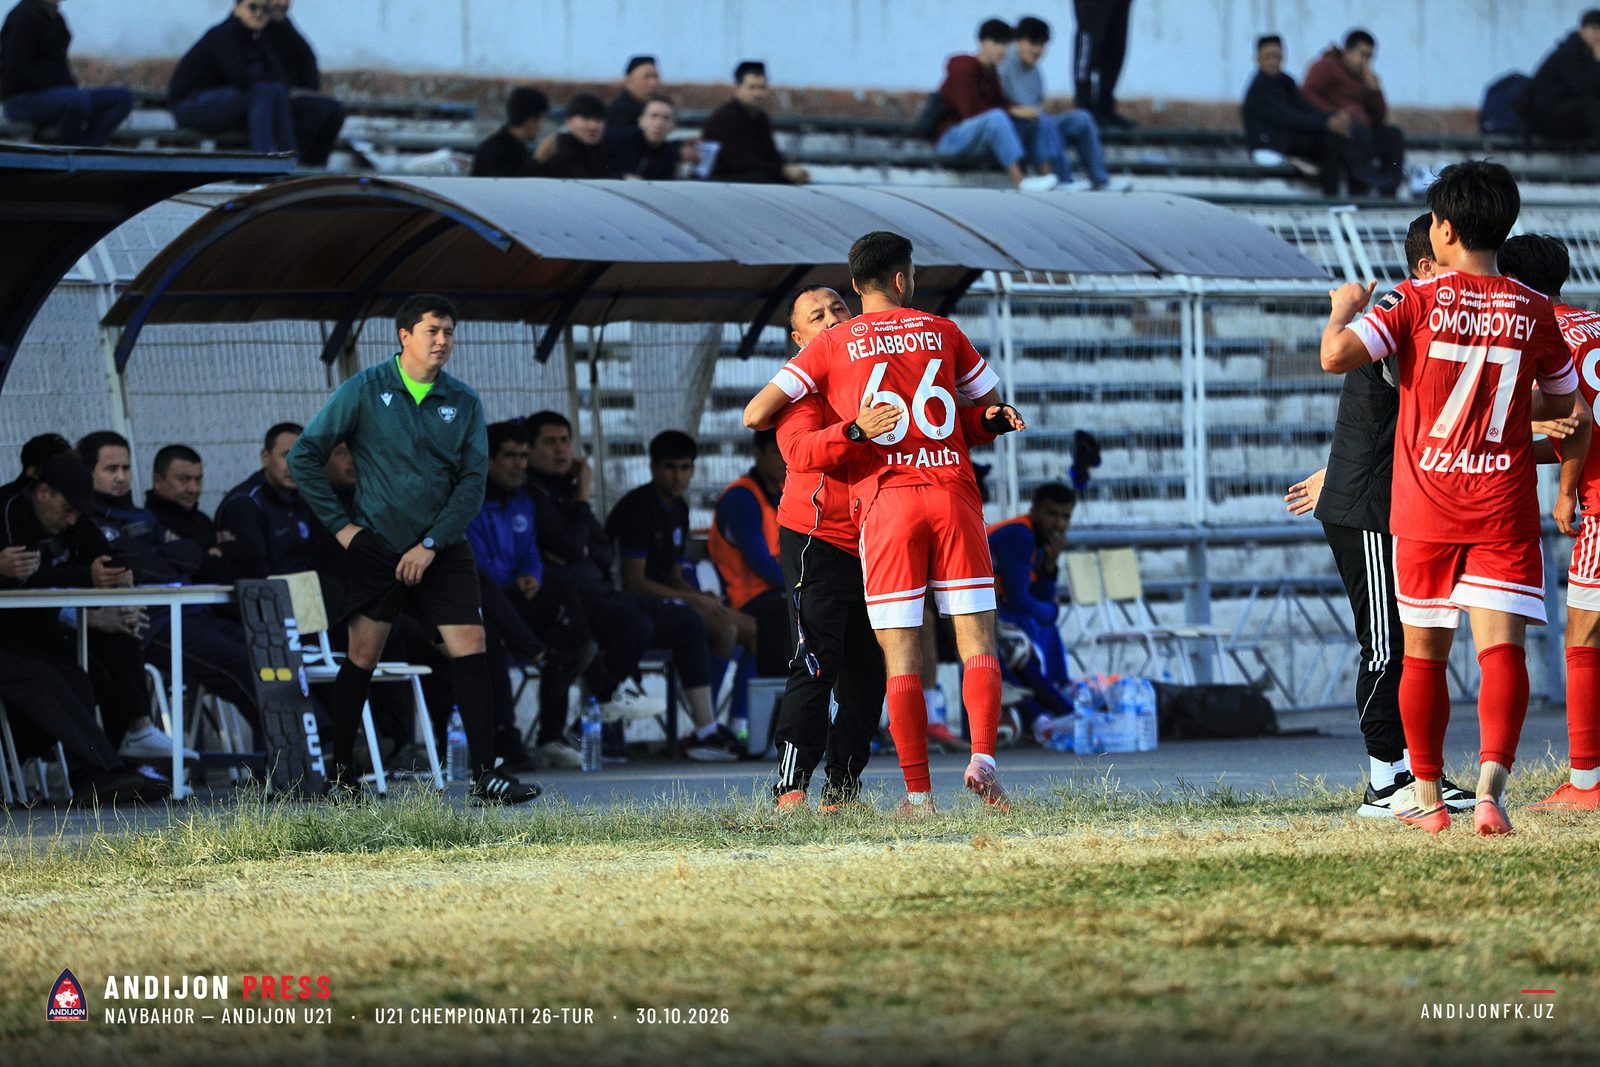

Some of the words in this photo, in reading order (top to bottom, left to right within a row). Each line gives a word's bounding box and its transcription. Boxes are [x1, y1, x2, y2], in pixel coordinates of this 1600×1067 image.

[1439, 292, 1452, 300] KU
[1460, 288, 1487, 300] Kokand
[1490, 291, 1530, 304] University
[1460, 297, 1491, 310] Andijon
[1492, 299, 1516, 309] filiali
[900, 315, 934, 324] University
[1429, 307, 1537, 341] OMONBOYEV
[846, 331, 943, 362] REJABBOYEV
[860, 358, 956, 446] 66
[1428, 340, 1522, 443] 77
[1418, 446, 1511, 474] UzAuto
[284, 618, 301, 651] IN
[302, 711, 326, 777] OUT
